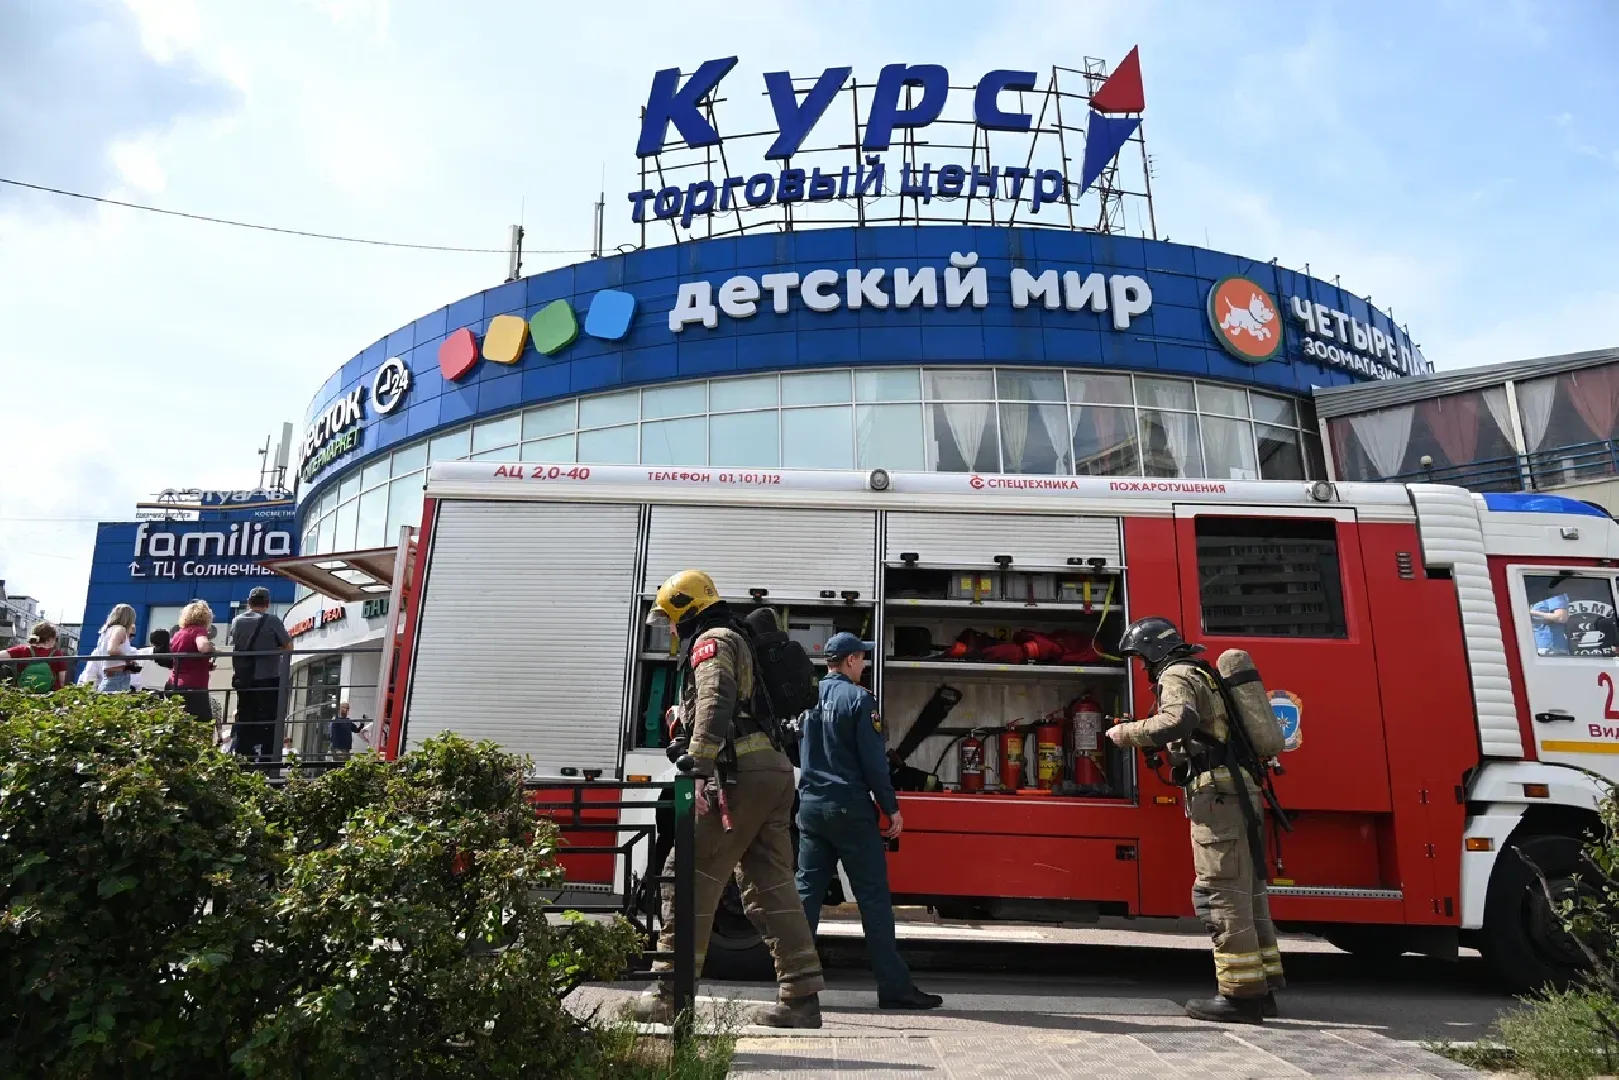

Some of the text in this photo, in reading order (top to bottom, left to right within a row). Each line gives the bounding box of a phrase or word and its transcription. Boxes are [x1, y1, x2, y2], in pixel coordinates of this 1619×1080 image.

[628, 154, 1064, 228] торговый центр
[669, 251, 1152, 332] детский мир
[1291, 296, 1399, 367] ЧЕТЫРЕ
[494, 465, 590, 481] АЦ 2,0-40
[647, 471, 710, 483] ТЕЛЕФОН
[988, 478, 1079, 490] СПЕЦТЕХНИКА
[1109, 482, 1226, 494] ПОЖАРОТУШЕНИЯ
[134, 522, 291, 557] familia
[153, 561, 176, 579] ТЦ
